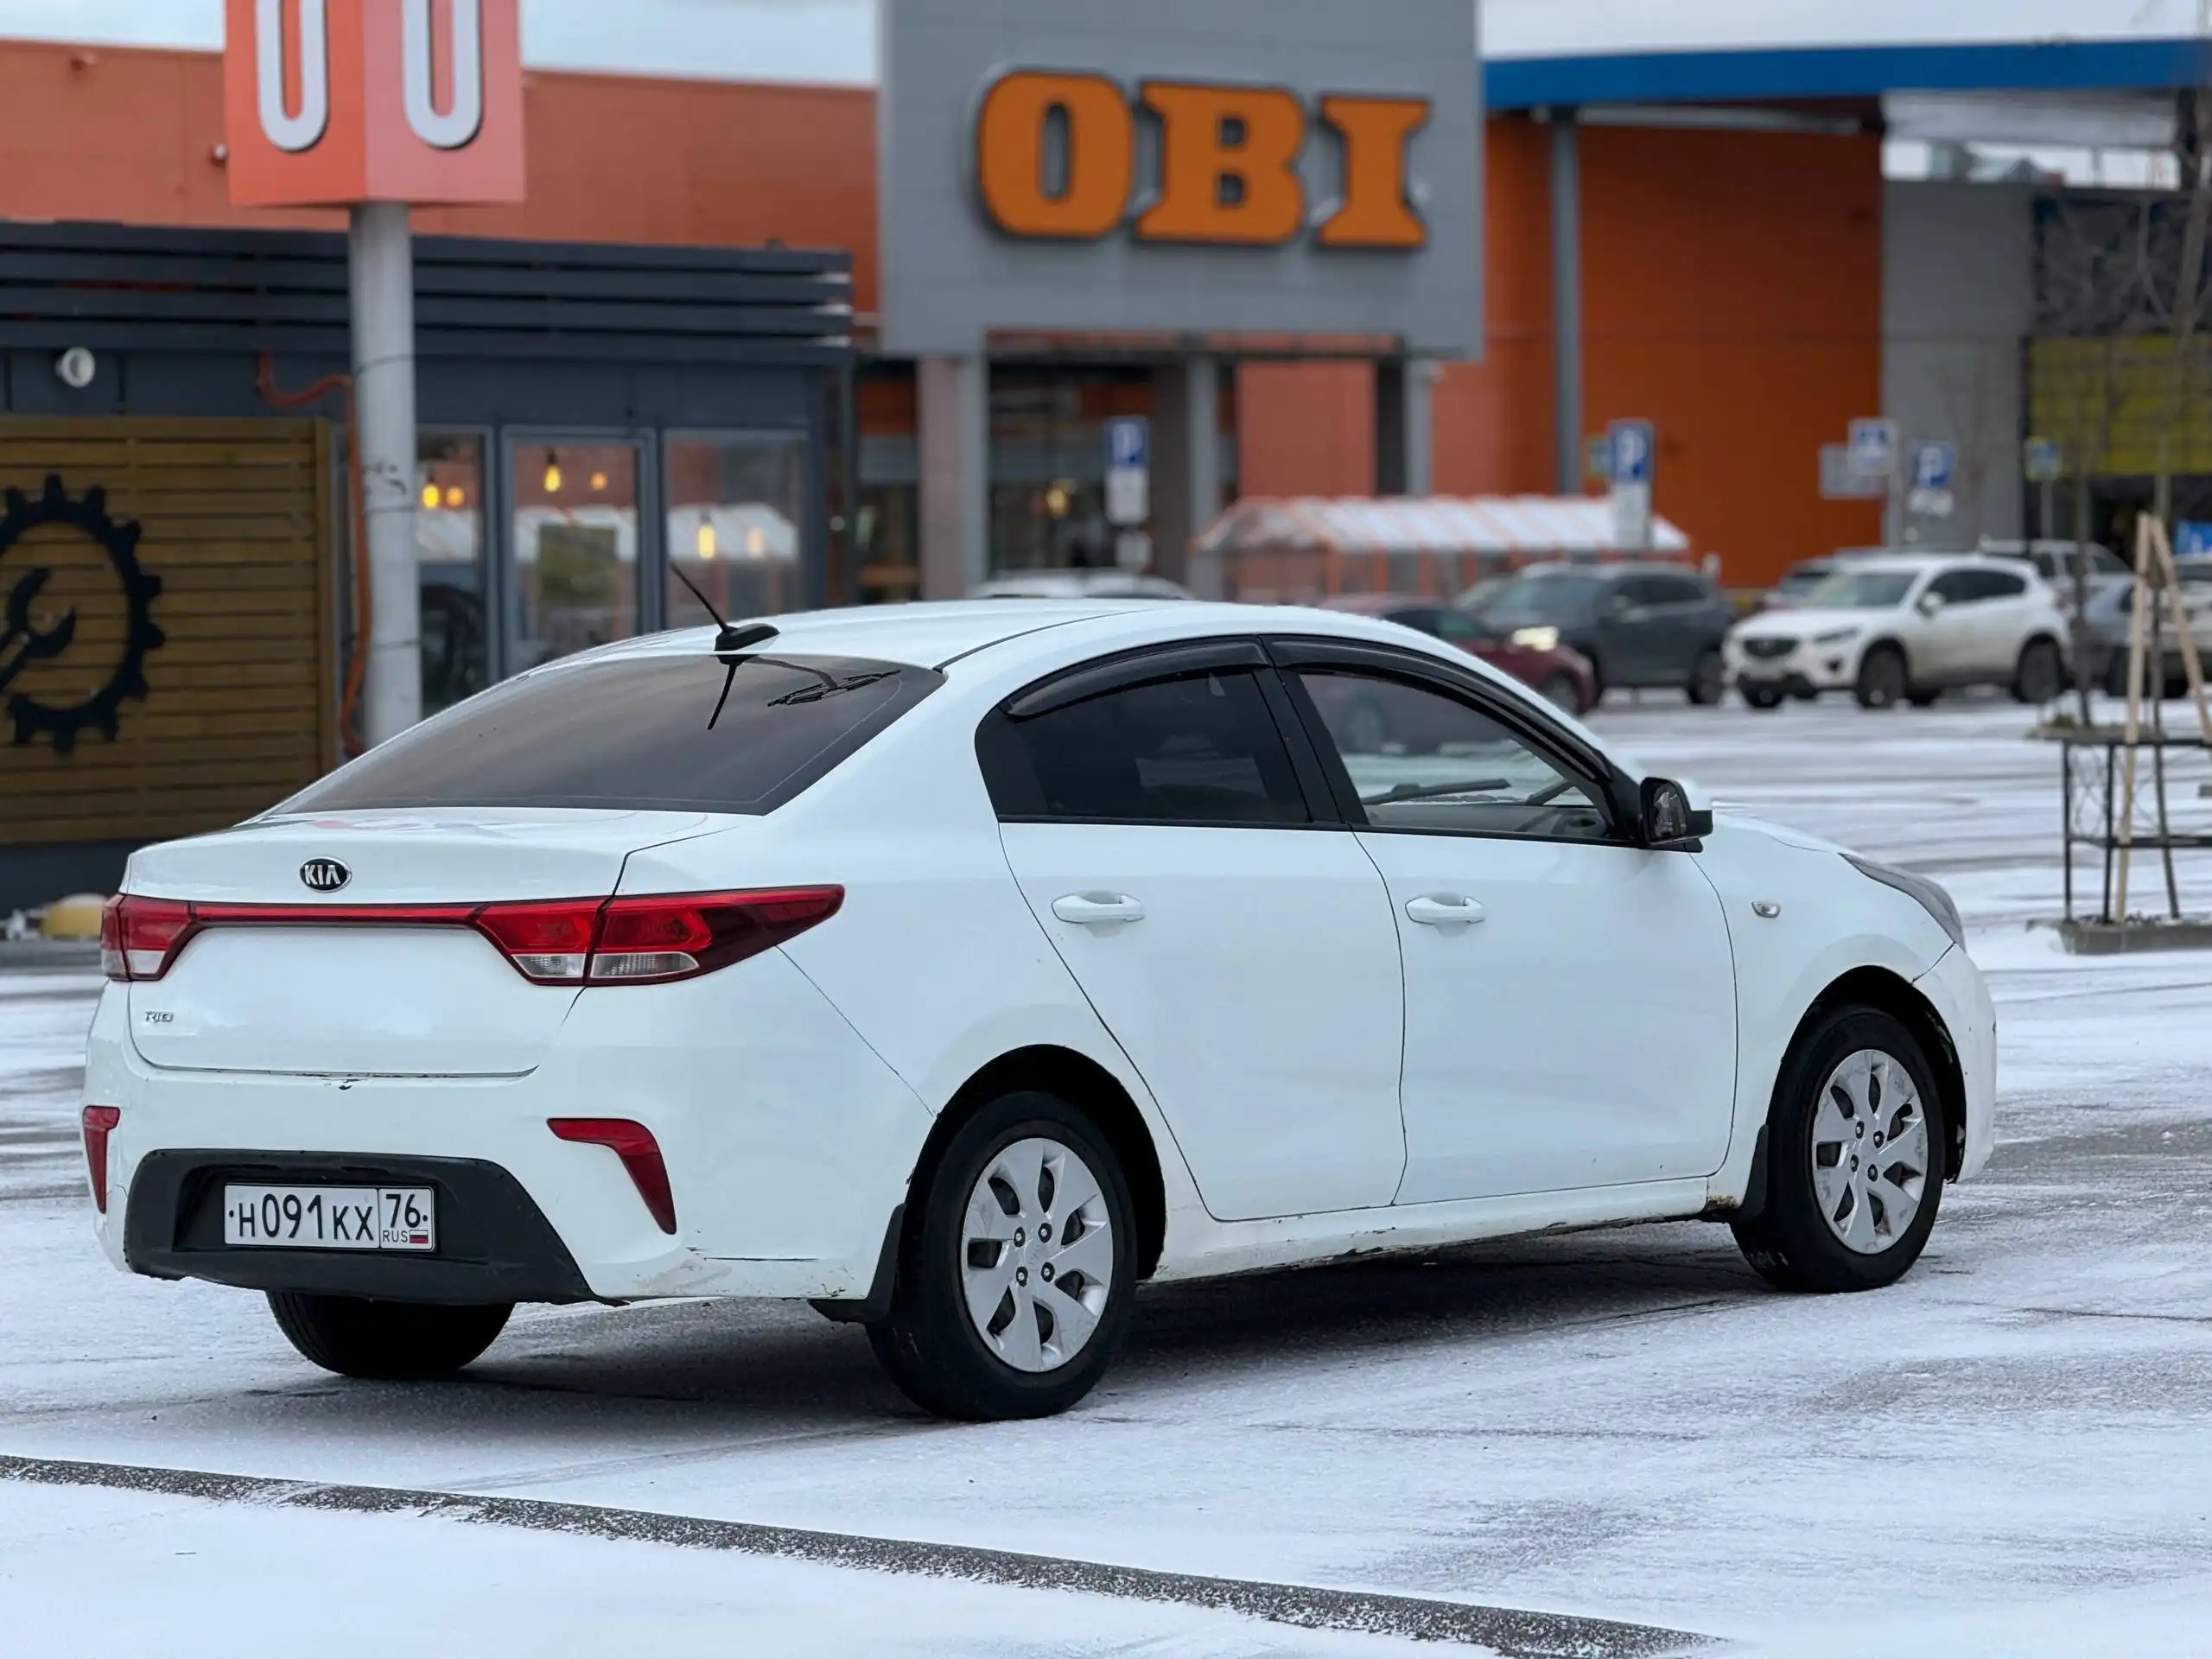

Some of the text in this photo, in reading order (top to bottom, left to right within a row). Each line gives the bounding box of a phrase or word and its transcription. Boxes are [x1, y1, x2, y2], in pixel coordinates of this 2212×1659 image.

[977, 71, 1429, 245] OBI
[304, 864, 341, 886] KIA
[382, 1230, 409, 1243] RUS
